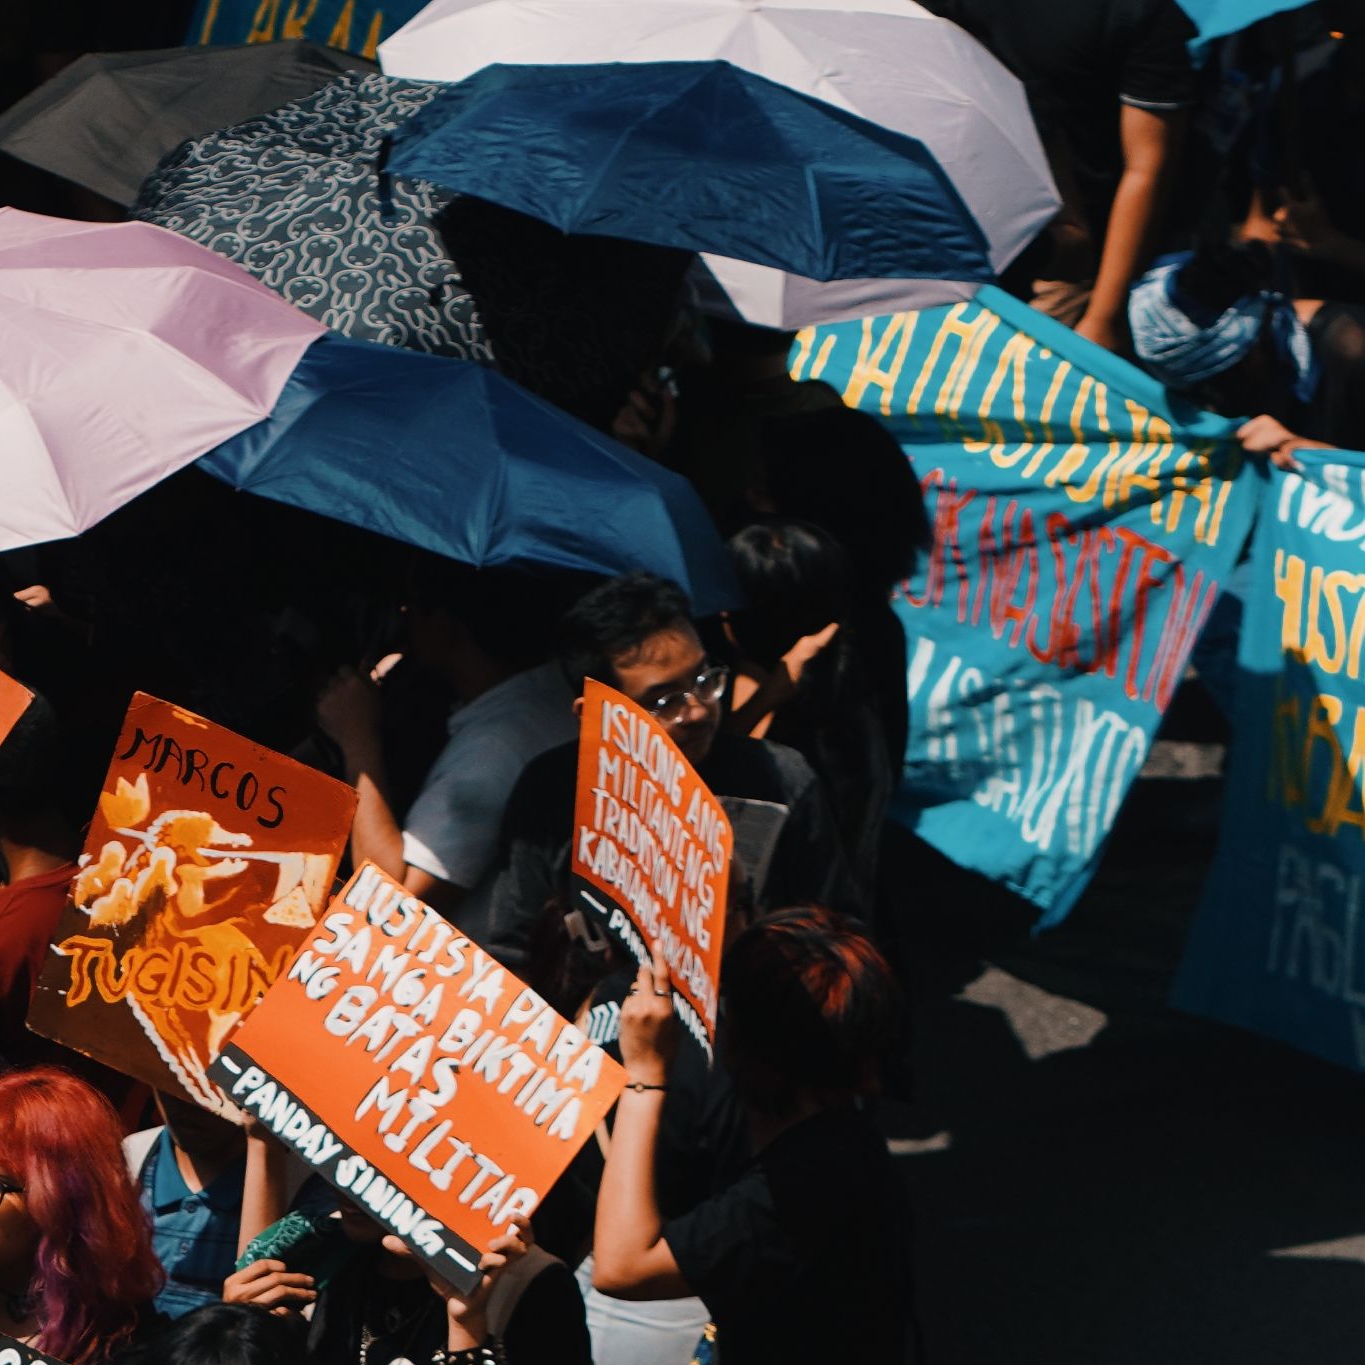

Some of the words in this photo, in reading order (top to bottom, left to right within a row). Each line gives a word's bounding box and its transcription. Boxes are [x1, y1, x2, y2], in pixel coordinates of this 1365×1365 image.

[118, 726, 289, 830] MARCOS
[286, 948, 334, 1001] NG
[324, 985, 460, 1106] BATAS
[312, 911, 368, 967] SA
[360, 948, 439, 1023] MGA
[439, 1006, 588, 1141] BIKTIMA
[506, 988, 605, 1093] PARA
[231, 1060, 346, 1167] PANDAY
[334, 1153, 447, 1260] SINING
[354, 1075, 539, 1236] MILITAR
